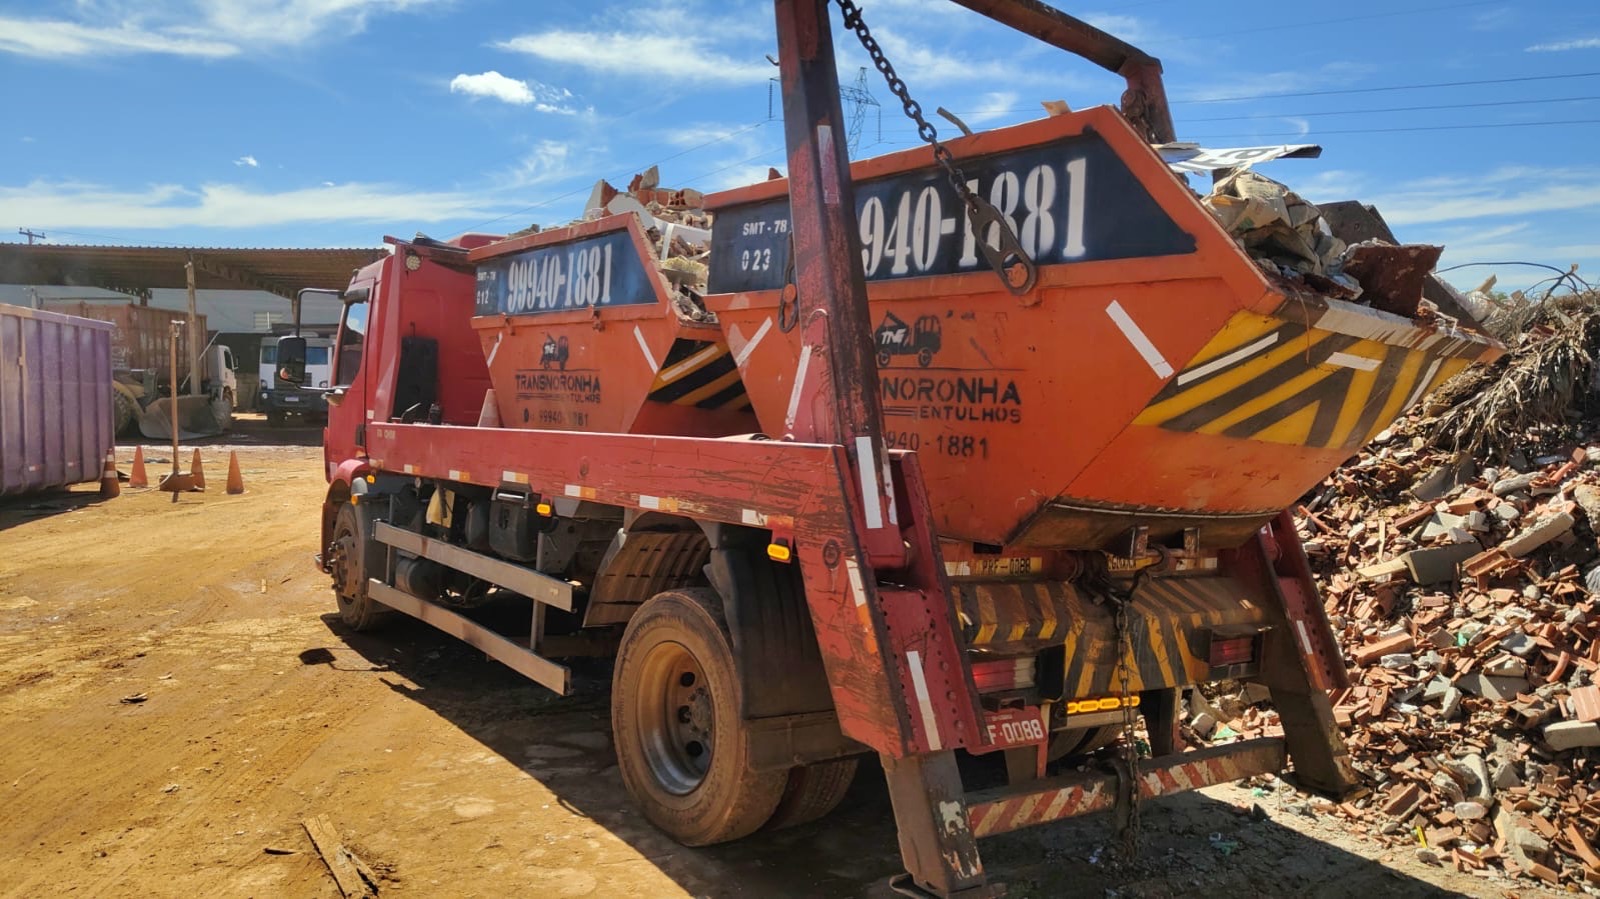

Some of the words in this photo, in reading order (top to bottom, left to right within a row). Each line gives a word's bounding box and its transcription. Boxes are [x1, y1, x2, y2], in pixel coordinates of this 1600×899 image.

[507, 242, 613, 312] 99940-1881
[515, 374, 601, 393] TRANSNORONHA
[919, 405, 1022, 424] ENTULHOS
